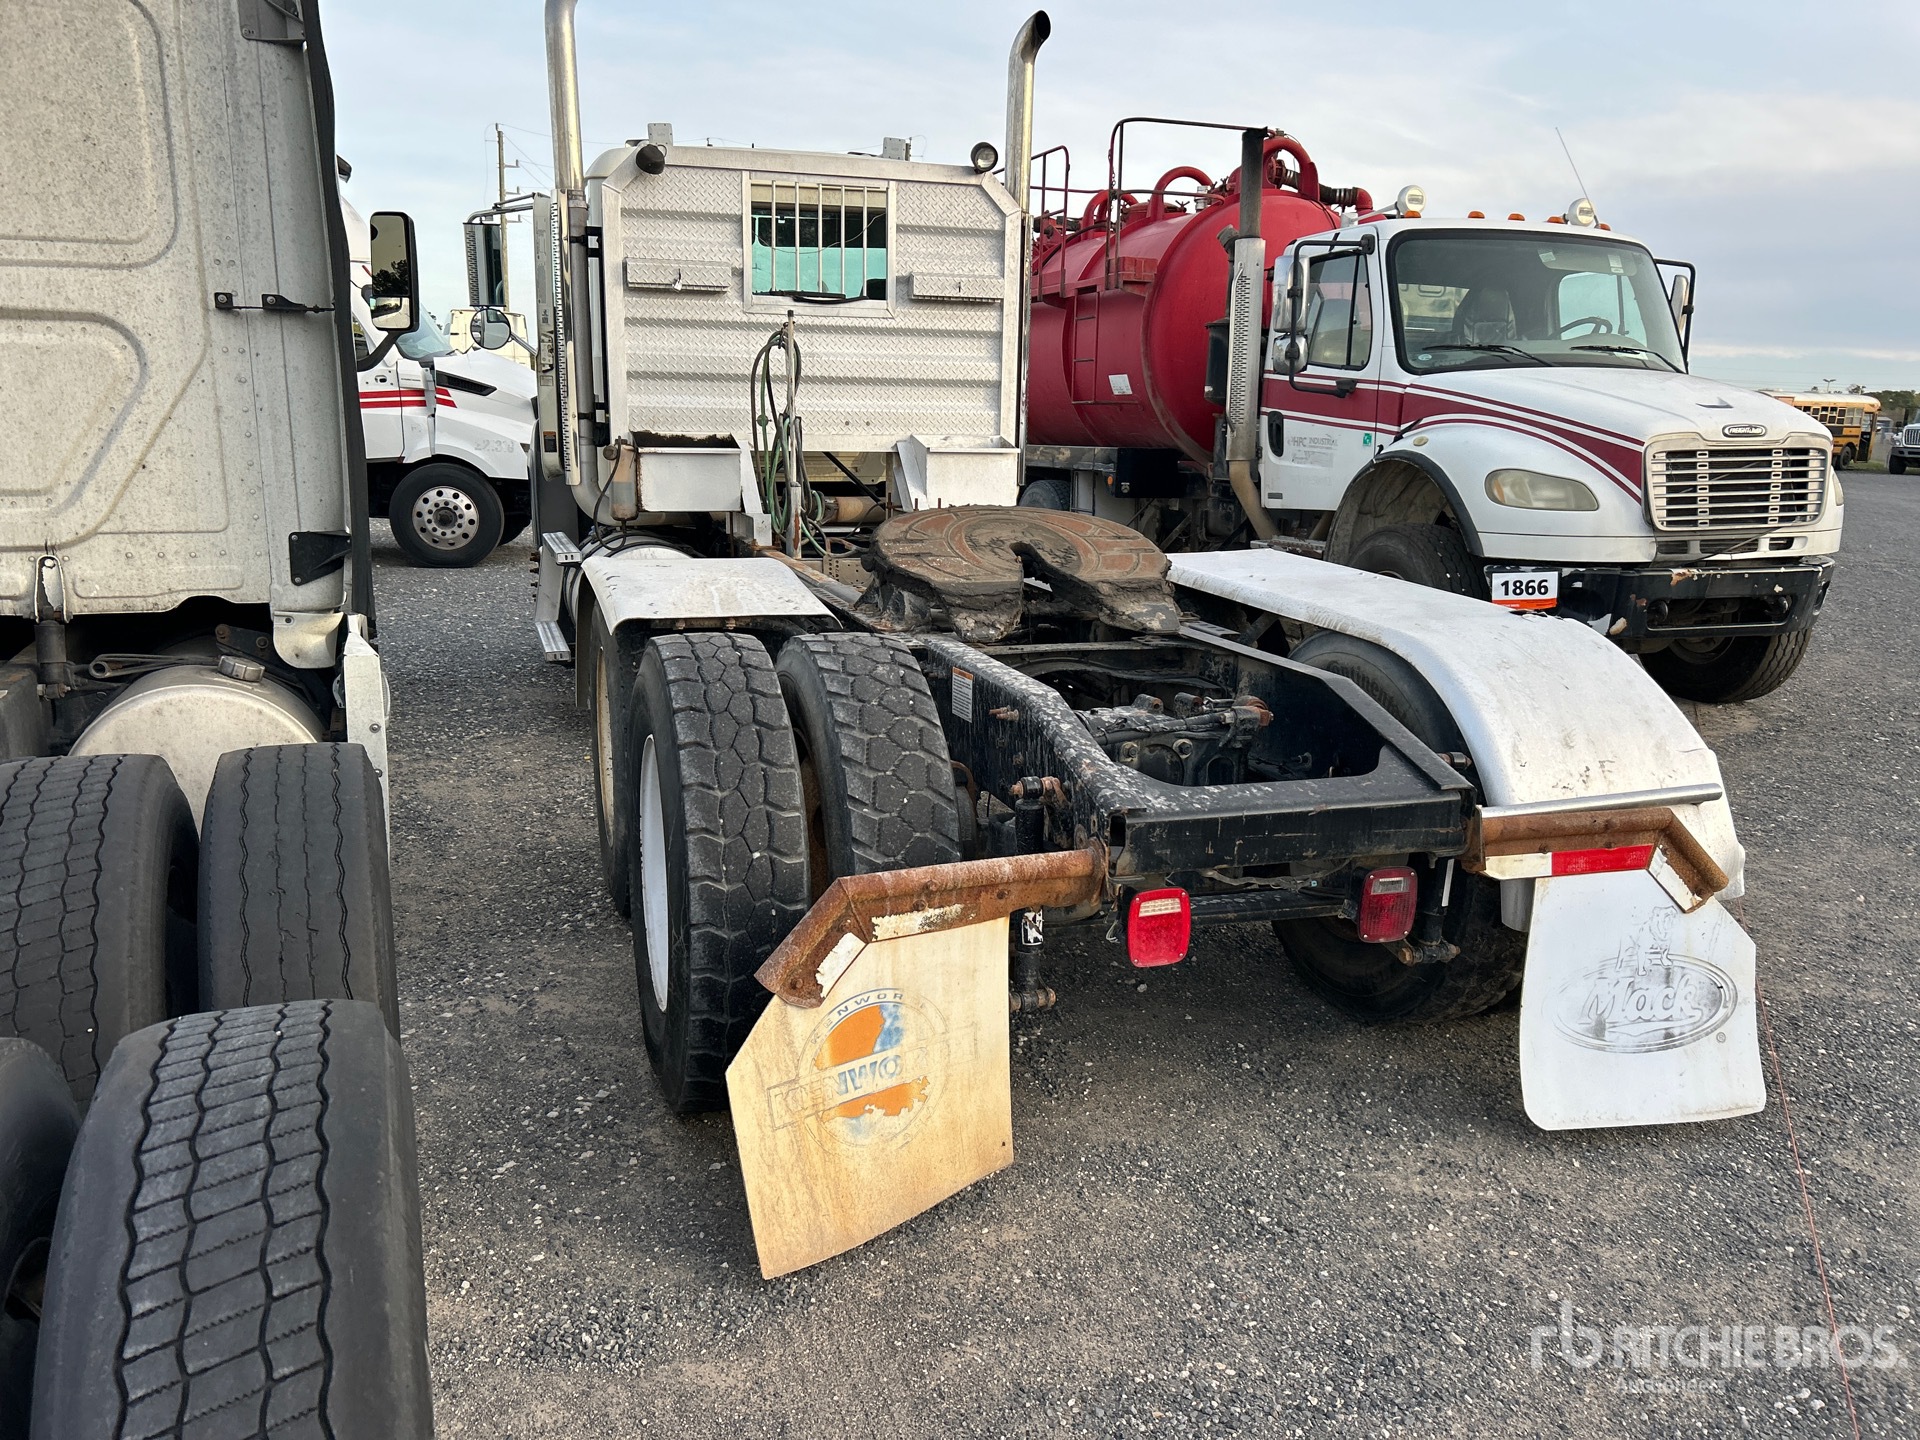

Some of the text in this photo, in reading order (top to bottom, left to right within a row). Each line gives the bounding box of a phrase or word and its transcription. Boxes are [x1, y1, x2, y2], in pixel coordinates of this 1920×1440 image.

[1500, 579, 1549, 596] 1866
[810, 992, 926, 1046] KENWOR
[1579, 973, 1703, 1027] Mack
